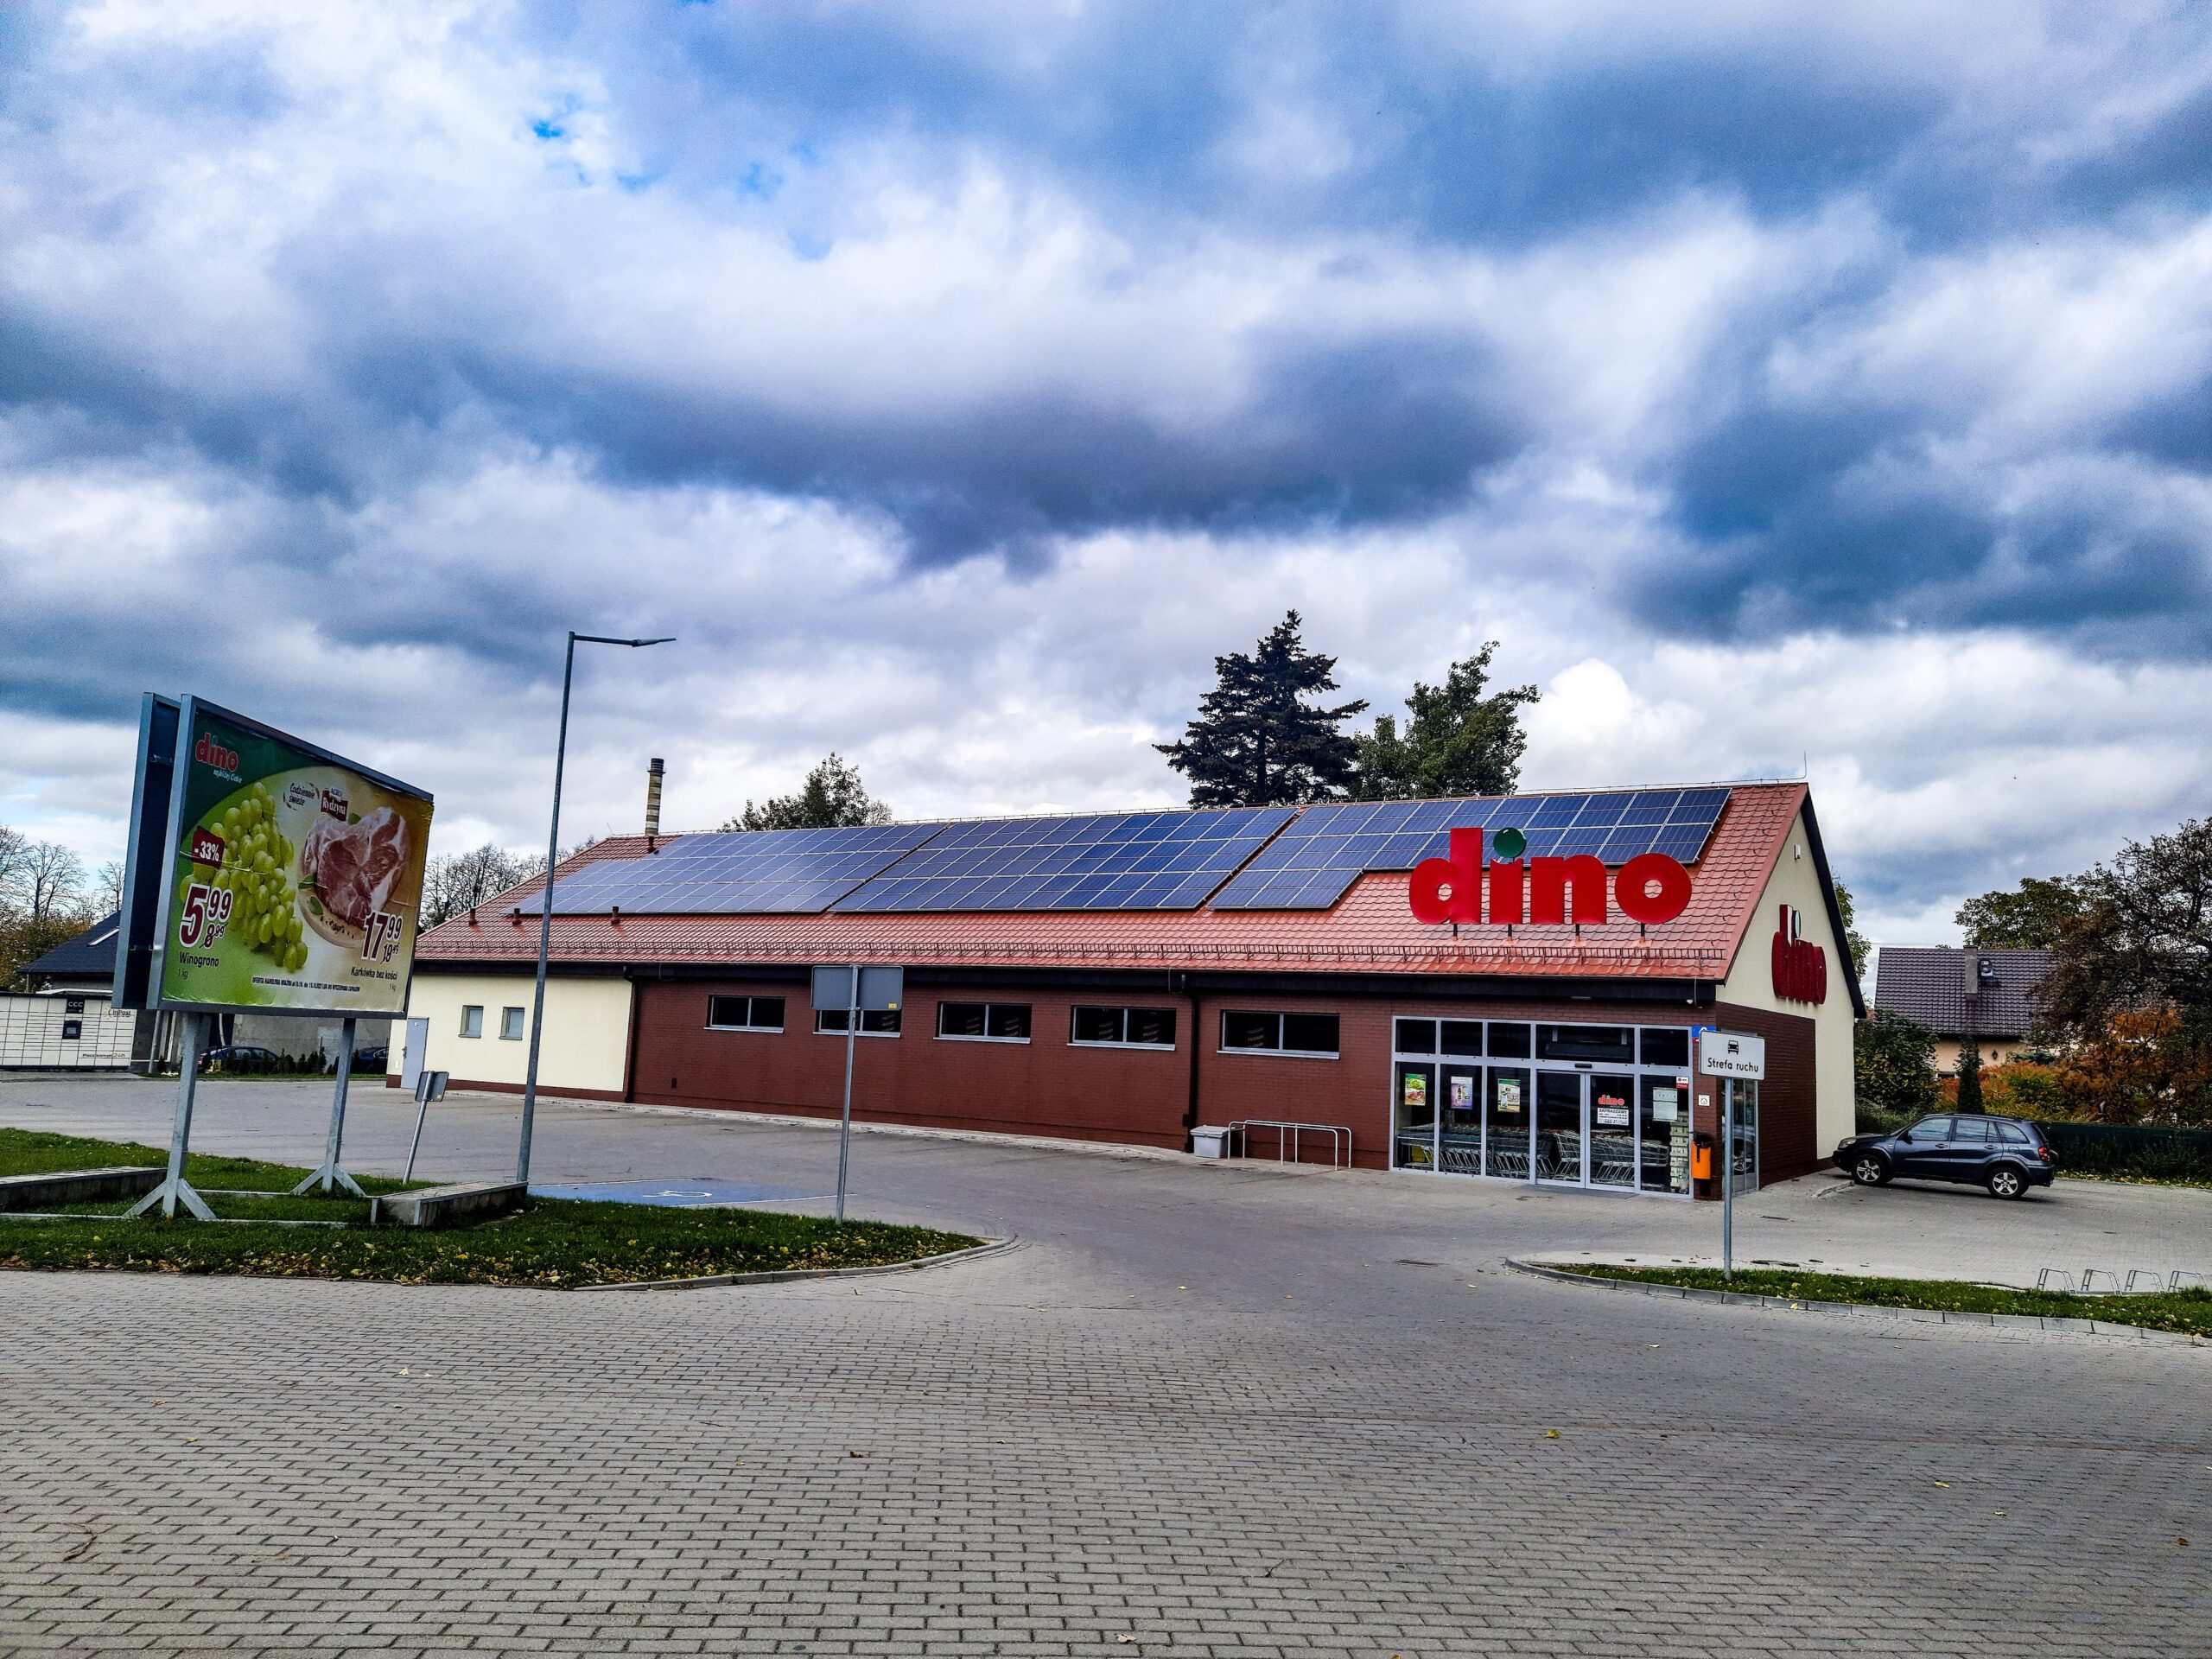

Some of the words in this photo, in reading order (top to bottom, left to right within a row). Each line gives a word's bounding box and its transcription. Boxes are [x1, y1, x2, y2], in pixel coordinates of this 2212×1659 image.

[195, 732, 238, 772] dino
[322, 797, 346, 815] Rydzyna
[1409, 827, 1693, 925] dino
[180, 951, 219, 967] Winogrono
[351, 966, 375, 978] Karkówka
[376, 969, 385, 979] bez
[1707, 1057, 1732, 1070] Strefa
[1736, 1062, 1758, 1072] ruchu
[1599, 1094, 1624, 1106] dino
